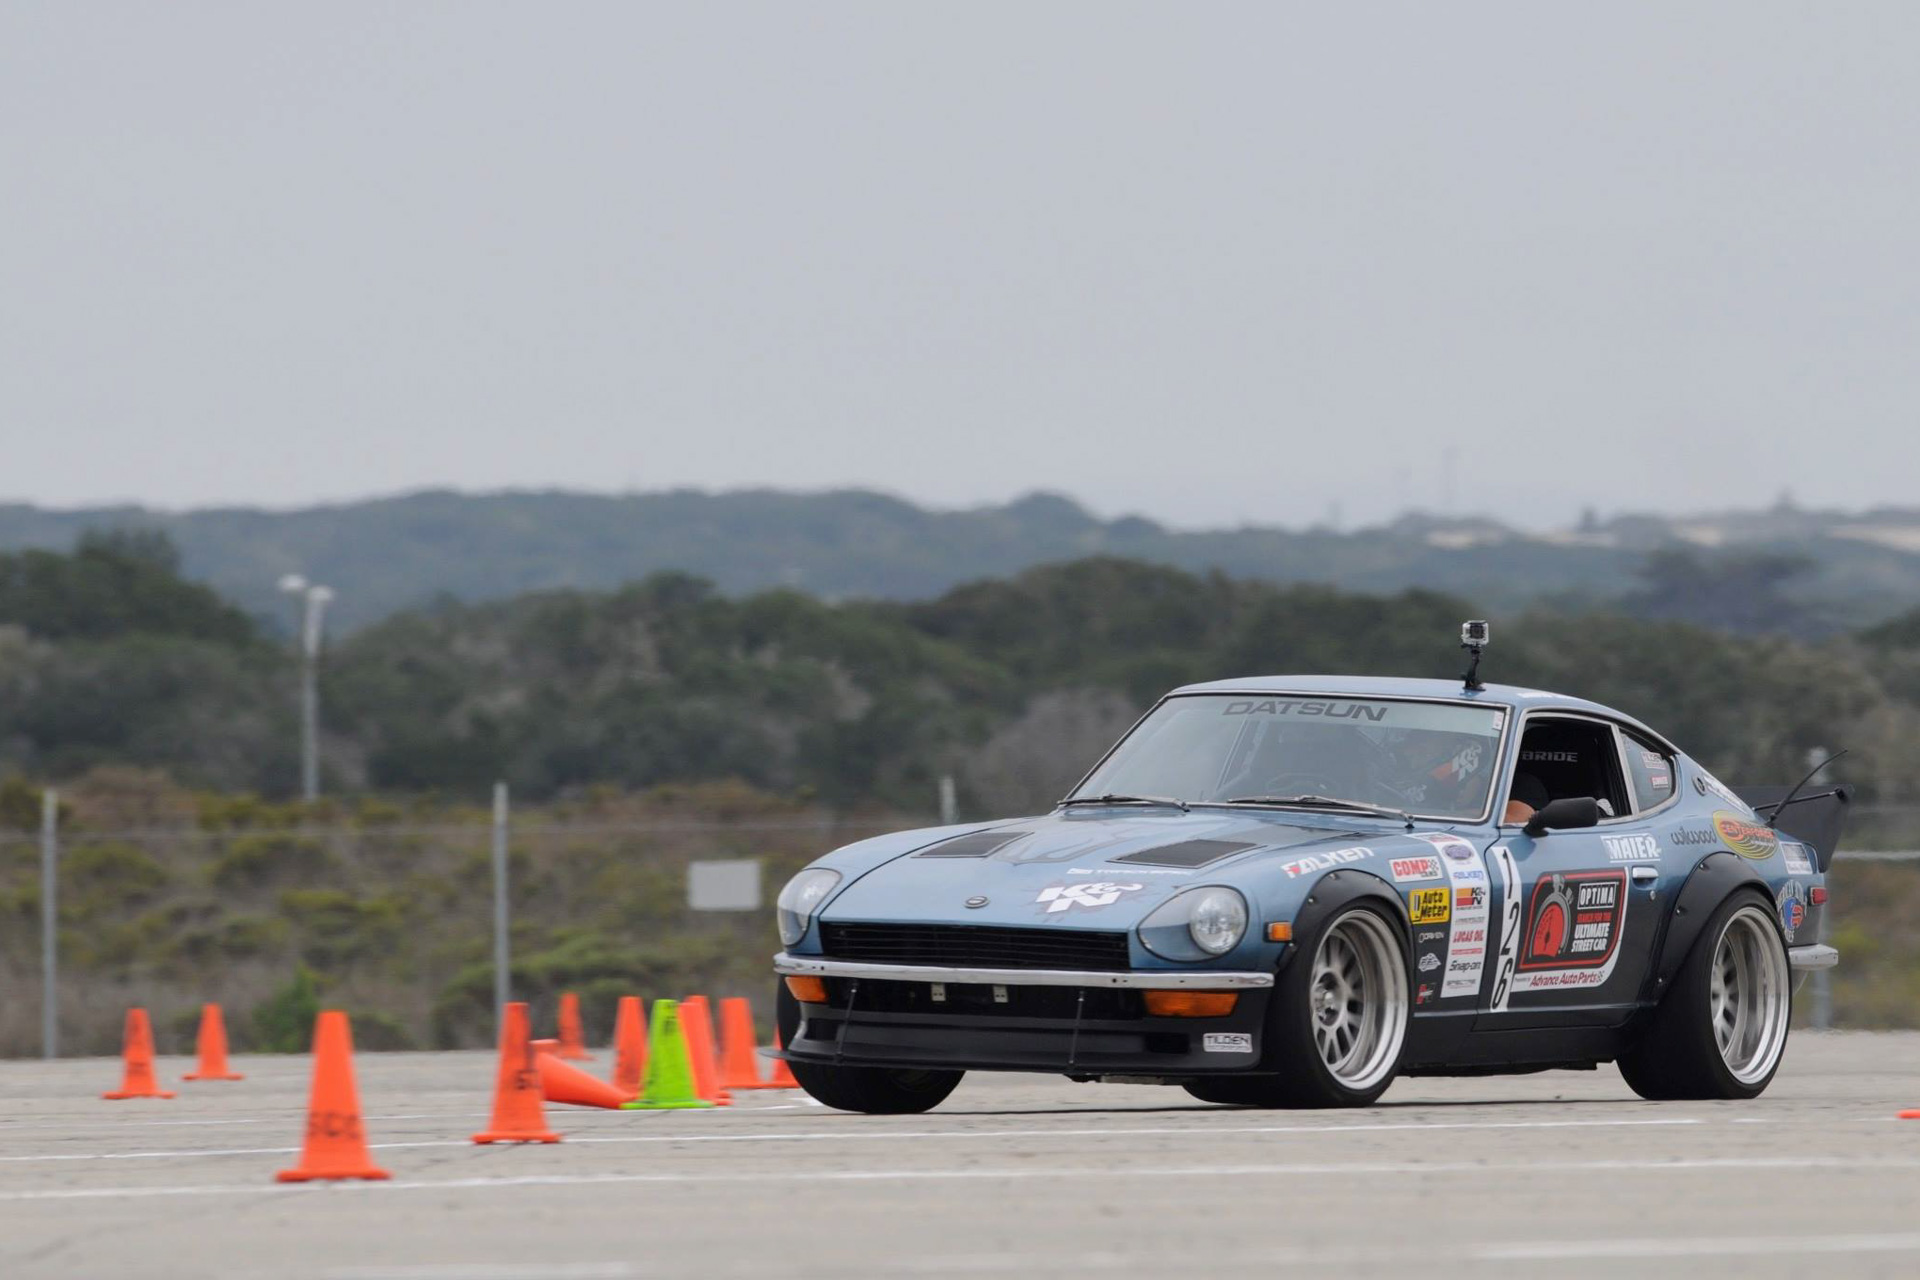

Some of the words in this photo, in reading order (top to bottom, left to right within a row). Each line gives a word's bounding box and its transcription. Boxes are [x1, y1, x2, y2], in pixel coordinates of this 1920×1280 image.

[1222, 701, 1388, 722] DATSUN
[1522, 751, 1578, 763] BRIDE
[1605, 835, 1661, 859] MAIER
[1281, 846, 1374, 879] FALKEN
[1393, 859, 1428, 876] COMP
[1036, 882, 1143, 913] K&N
[1422, 892, 1443, 904] Auto
[1580, 886, 1614, 906] OPTIMA
[1420, 905, 1448, 918] Meter
[1453, 931, 1472, 943] LUCAS
[1473, 929, 1484, 942] OIL
[1574, 922, 1610, 939] ULTIMATE
[1571, 938, 1594, 952] STREET
[1593, 938, 1607, 951] CAR
[1449, 960, 1482, 973] Snap-on
[1529, 974, 1560, 987] Advance
[1560, 972, 1578, 986] Auto
[1577, 972, 1597, 985] Parts
[1206, 1035, 1249, 1045] TILDEN
